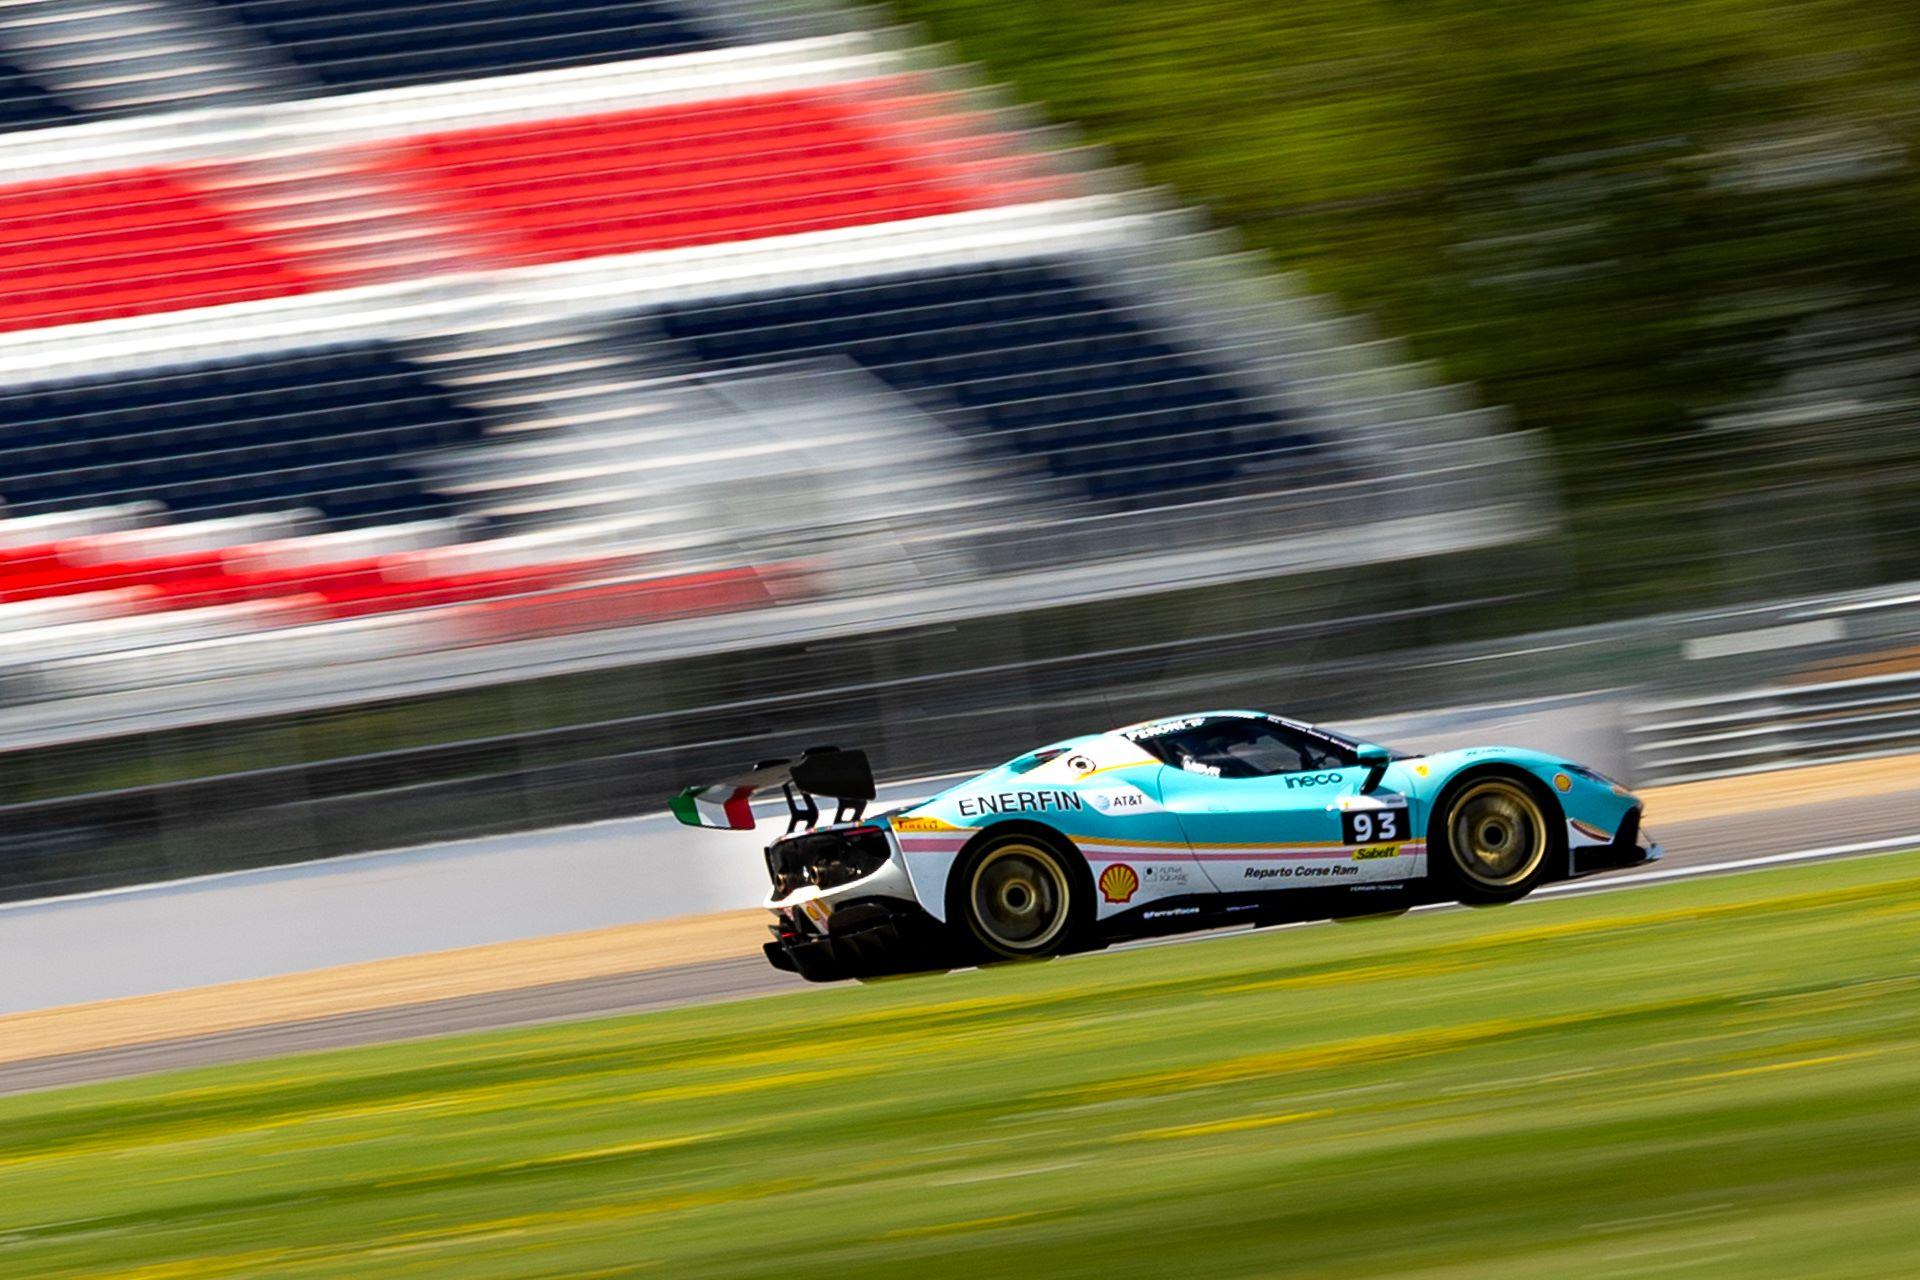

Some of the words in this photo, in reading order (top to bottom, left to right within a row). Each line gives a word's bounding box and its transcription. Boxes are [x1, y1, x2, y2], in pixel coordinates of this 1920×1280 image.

[959, 791, 1082, 817] ENERFIN
[1113, 794, 1143, 807] AT&T
[1353, 812, 1396, 842] 93
[1244, 867, 1292, 880] Reparto
[1295, 865, 1330, 877] Corse
[1331, 865, 1359, 876] Ram
